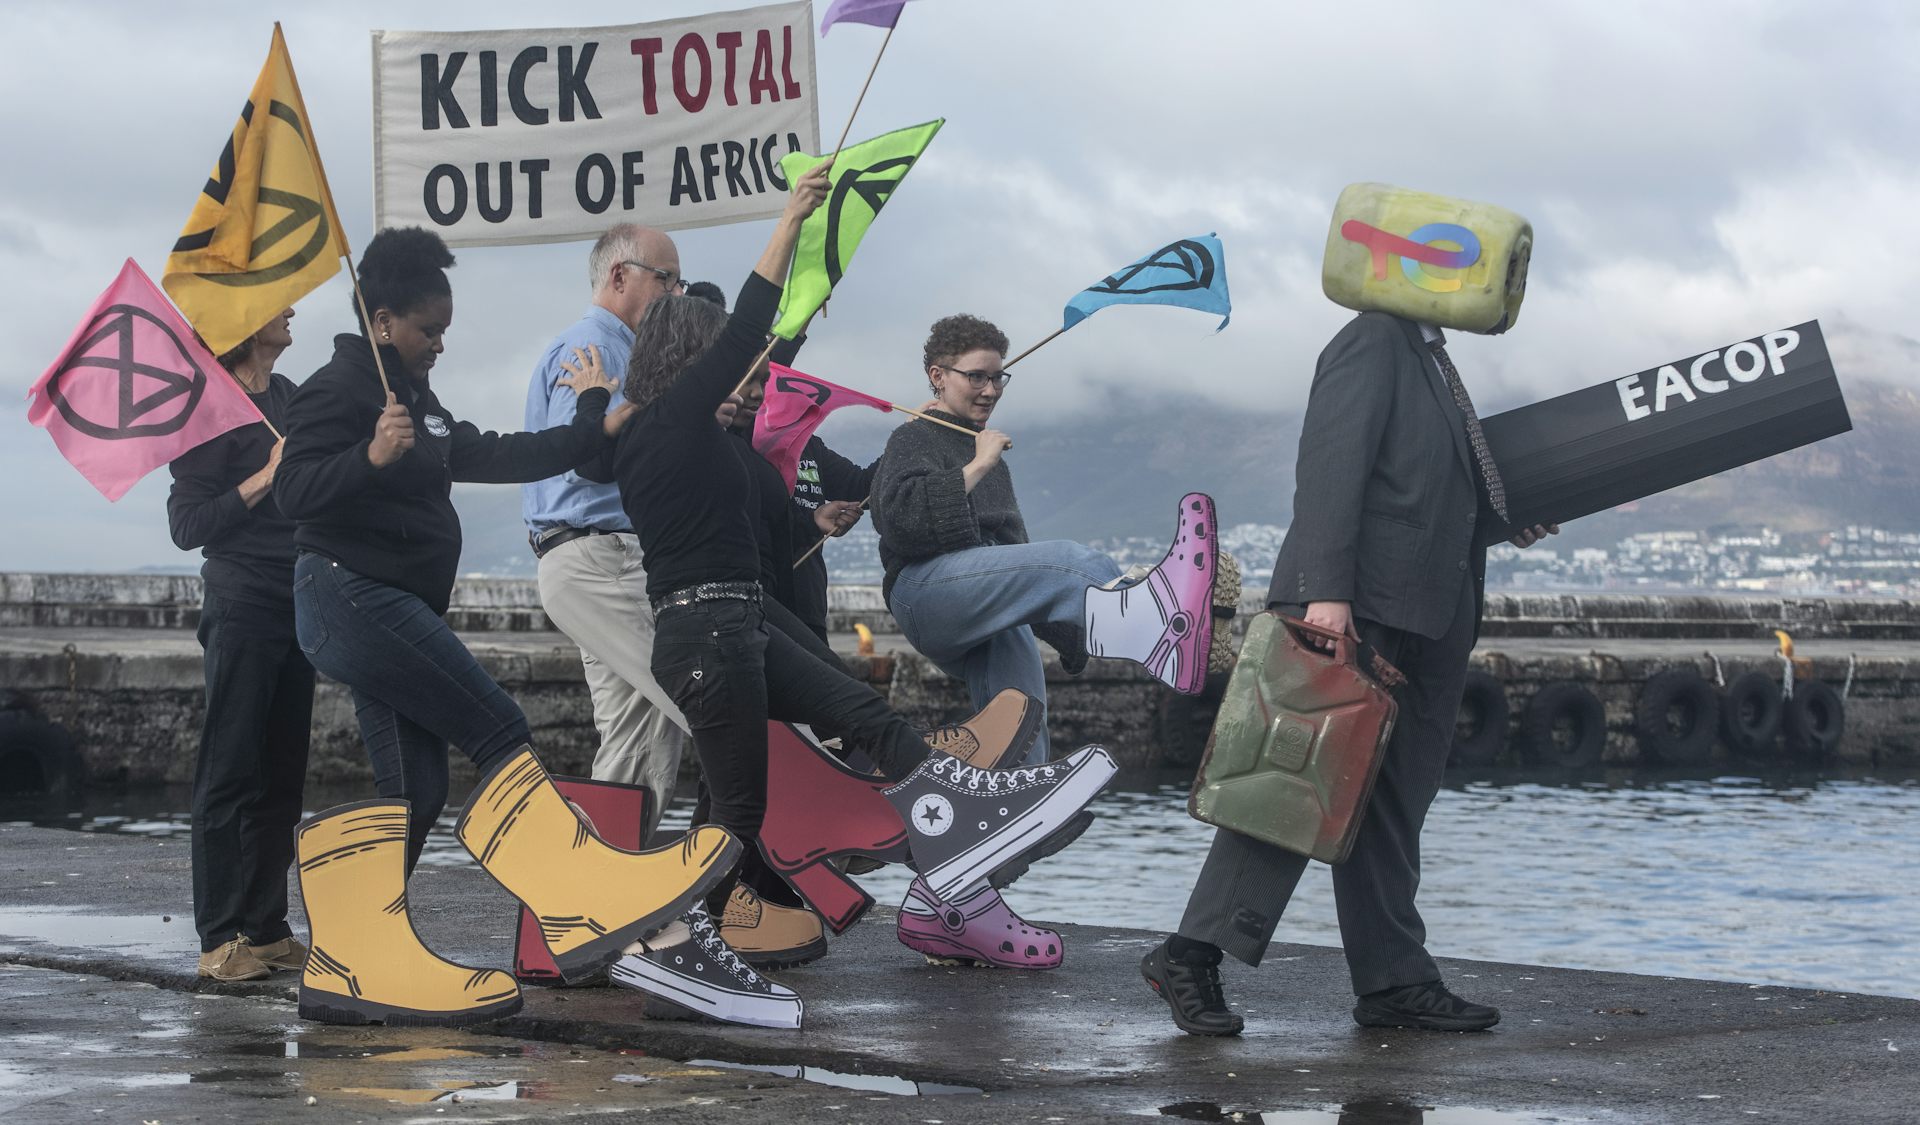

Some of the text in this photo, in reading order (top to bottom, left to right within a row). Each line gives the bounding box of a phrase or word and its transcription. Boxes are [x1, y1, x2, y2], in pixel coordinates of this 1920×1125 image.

[420, 25, 802, 131] KICK TOTAL
[423, 158, 551, 226] OUT
[575, 151, 645, 215] OF
[1615, 329, 1801, 422] EACOP
